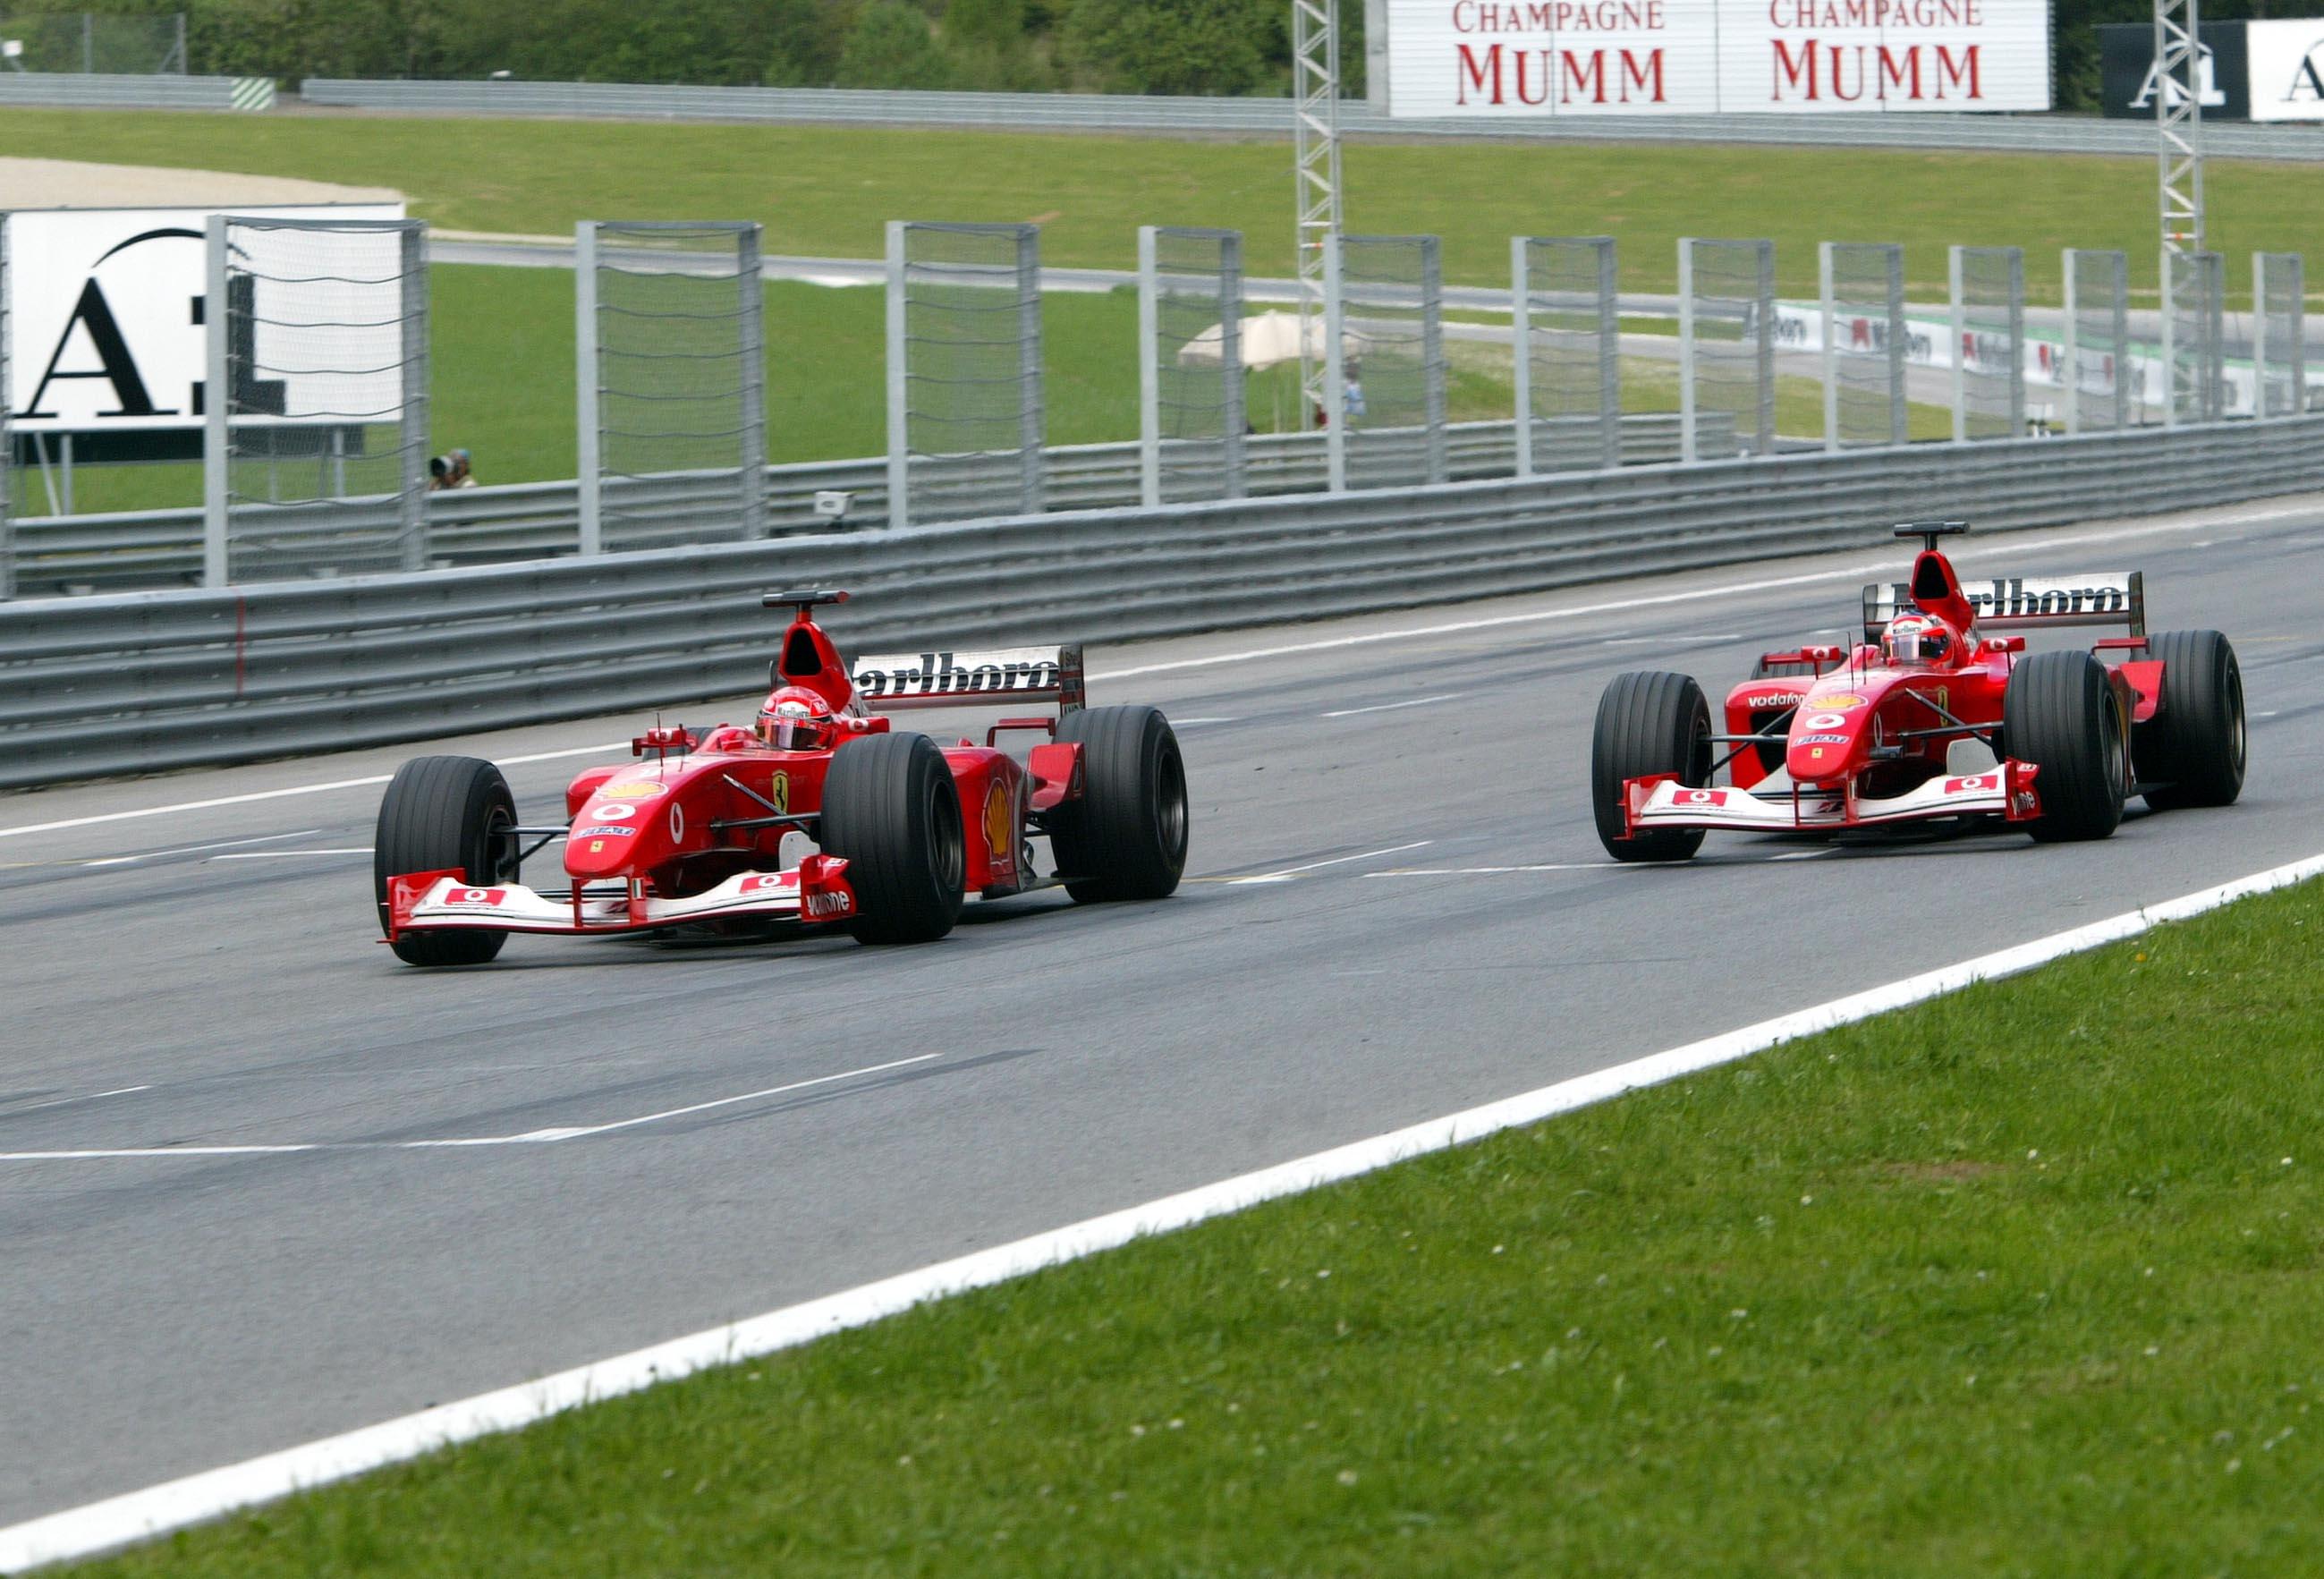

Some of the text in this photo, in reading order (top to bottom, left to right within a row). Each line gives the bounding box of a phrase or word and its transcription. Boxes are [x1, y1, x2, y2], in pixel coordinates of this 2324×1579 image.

[1453, 1, 1666, 33] CHAMPAGNE
[1770, 0, 1983, 28] CHAMPAGNE
[1455, 43, 1667, 105] MUMM
[1770, 38, 1984, 101] MUMM
[1890, 578, 2124, 618] rlboro
[857, 653, 1059, 697] arlboro
[1748, 692, 1807, 708] vodafon
